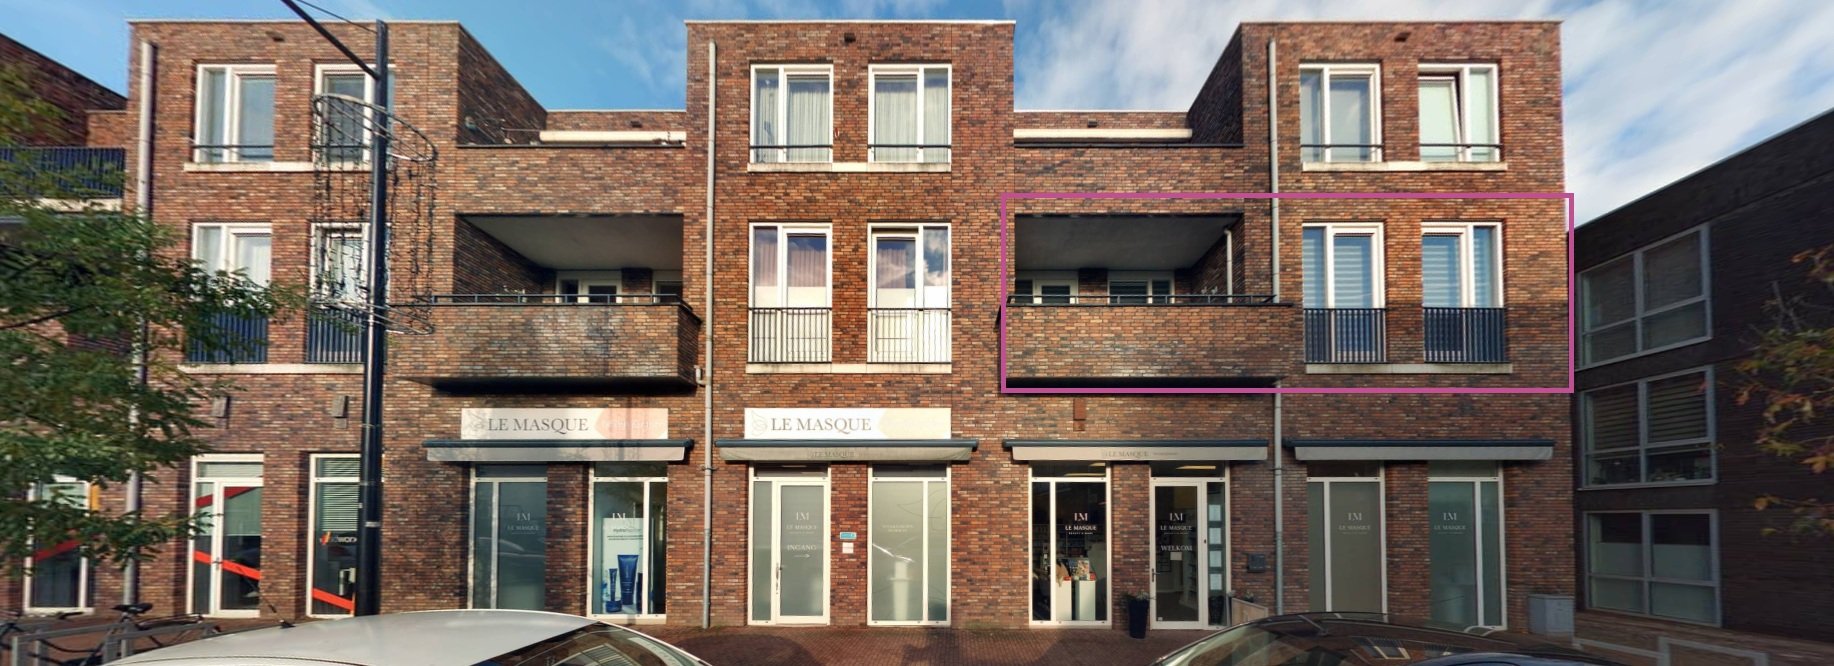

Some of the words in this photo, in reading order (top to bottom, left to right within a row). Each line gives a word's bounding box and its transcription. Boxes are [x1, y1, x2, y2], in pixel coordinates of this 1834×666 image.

[488, 418, 508, 431] LE
[513, 418, 588, 434] MASQUE
[771, 418, 792, 431] LE
[797, 418, 872, 434] MASQUE
